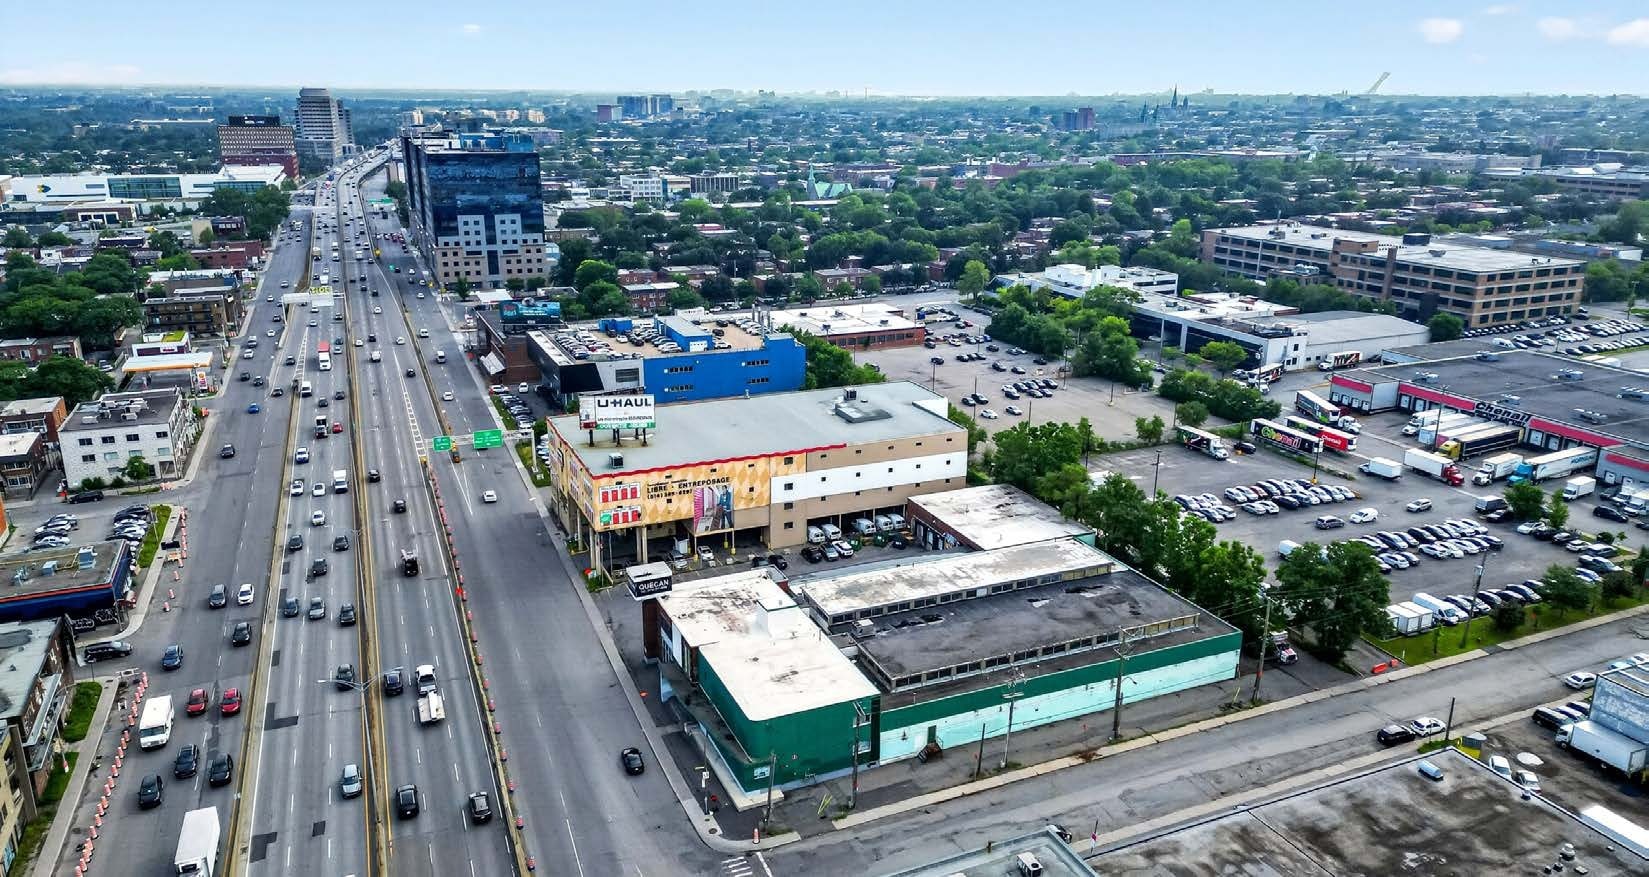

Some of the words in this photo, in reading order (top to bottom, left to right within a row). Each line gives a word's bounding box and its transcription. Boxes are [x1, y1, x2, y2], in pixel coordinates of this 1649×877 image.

[597, 398, 652, 407] U-HAUL
[1476, 402, 1531, 422] Chenail
[1261, 426, 1302, 448] Chenail
[647, 485, 667, 493] LIBRE
[678, 477, 730, 488] ENTREPOSAGE
